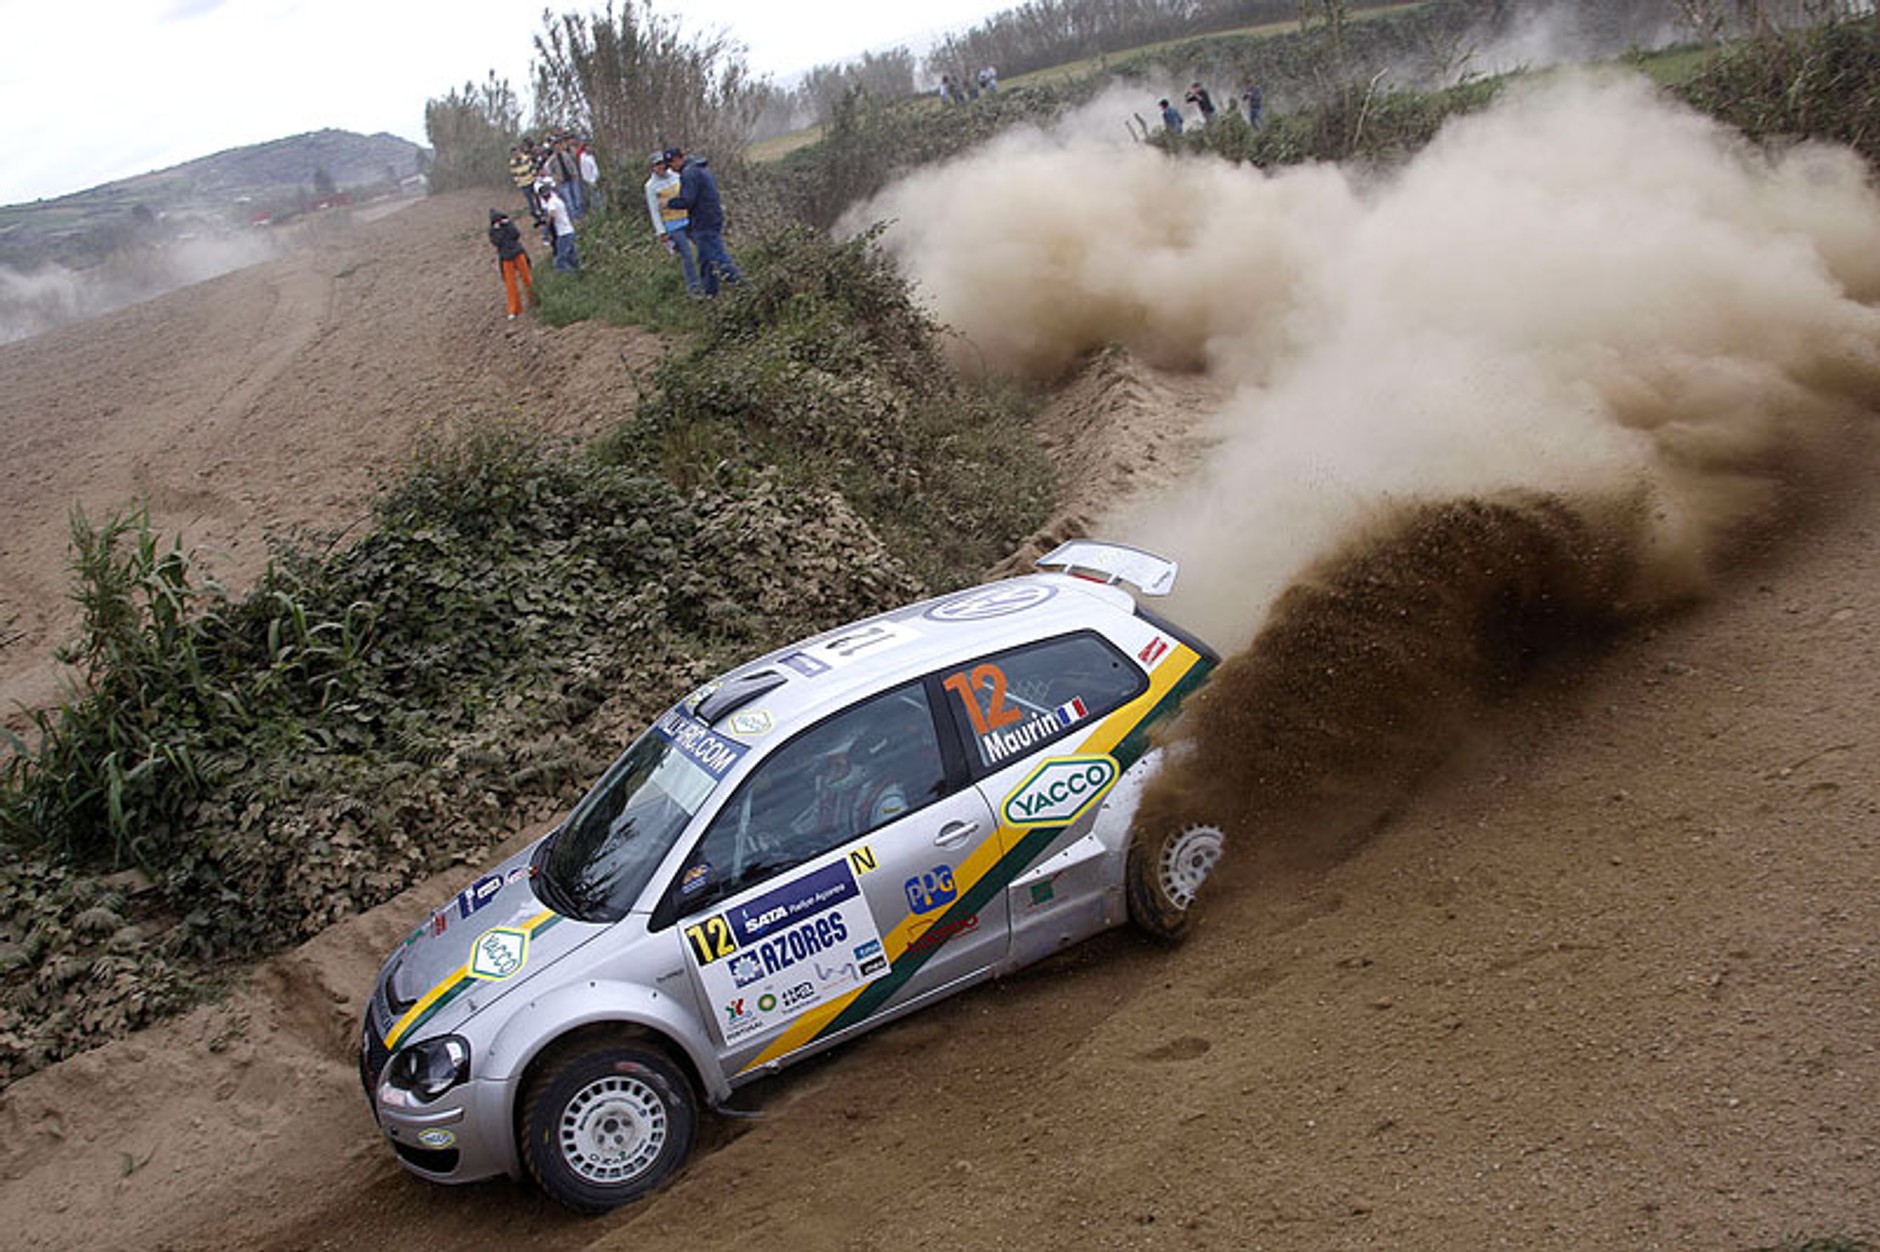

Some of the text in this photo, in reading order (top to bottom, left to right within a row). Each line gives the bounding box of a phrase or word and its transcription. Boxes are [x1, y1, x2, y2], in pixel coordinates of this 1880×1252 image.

[943, 663, 1023, 735] 12
[982, 711, 1059, 763] Maurin
[1015, 765, 1106, 816] YACCO
[850, 845, 876, 875] N
[907, 869, 953, 906] PPG
[686, 916, 735, 963] 12
[745, 906, 789, 934] SATA
[482, 935, 518, 974] YACCO
